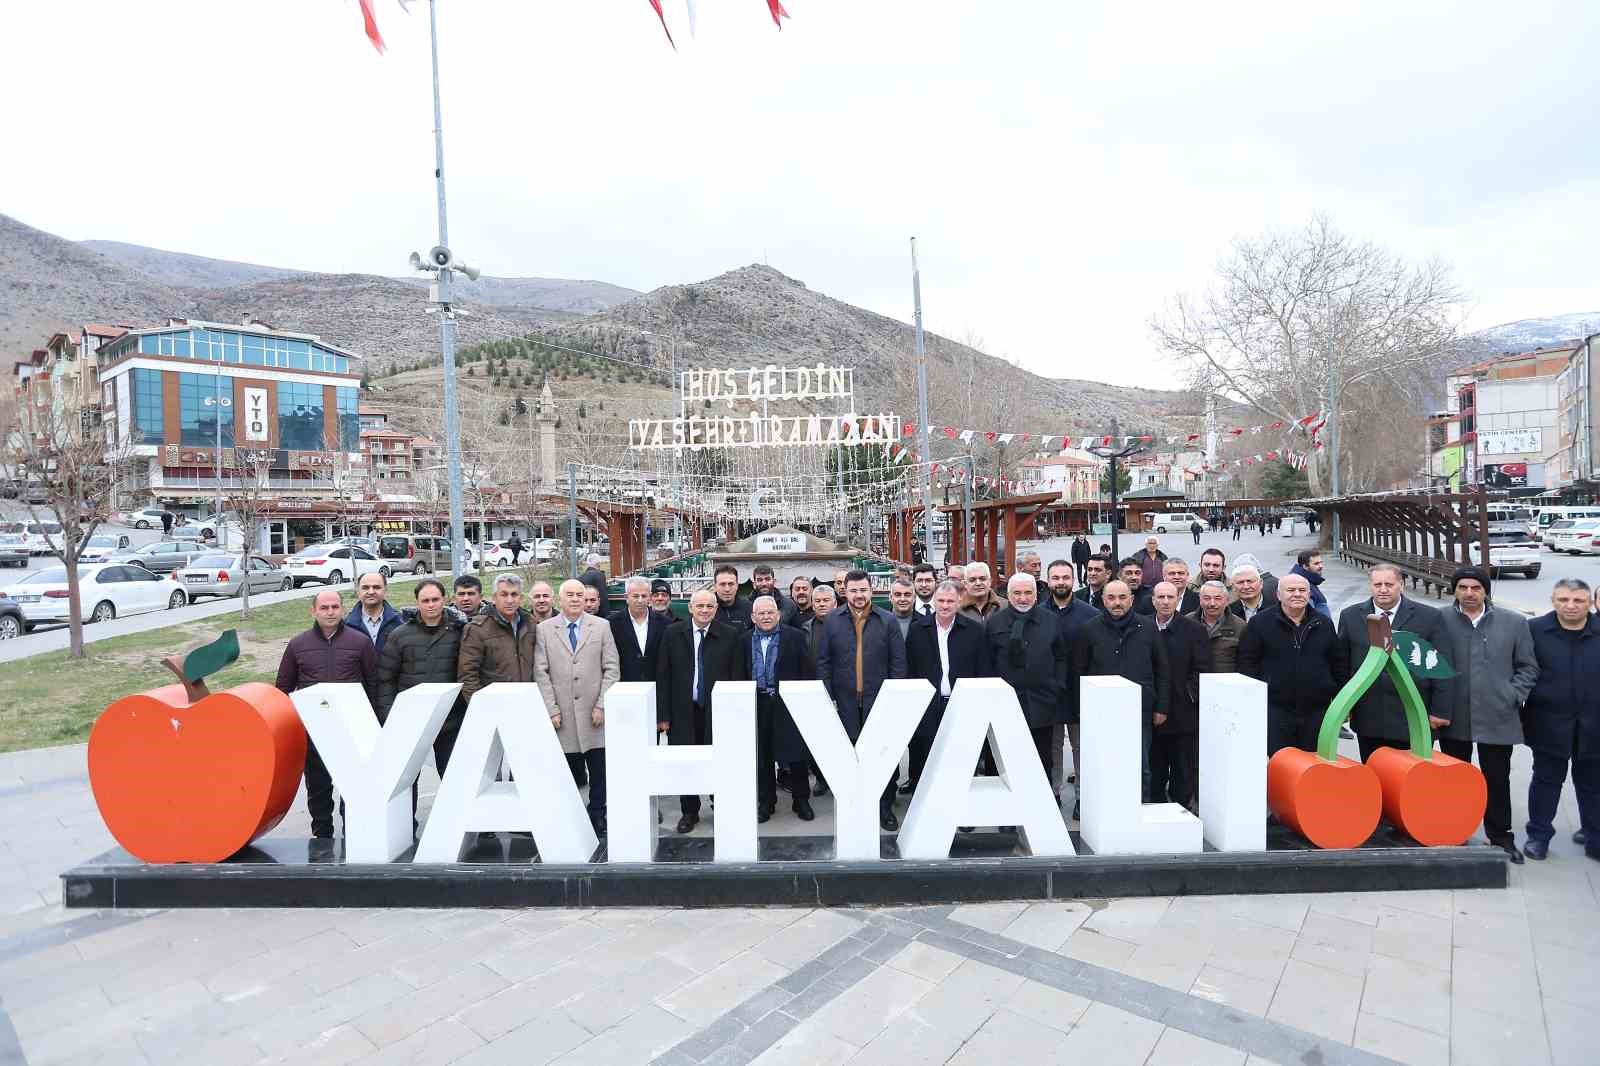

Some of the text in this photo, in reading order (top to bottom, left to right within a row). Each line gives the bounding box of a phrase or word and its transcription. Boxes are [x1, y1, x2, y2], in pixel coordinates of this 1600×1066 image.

[689, 362, 845, 408] HOŞ GELDİN
[638, 418, 663, 451] YA
[289, 673, 1268, 865] YAHYALI
